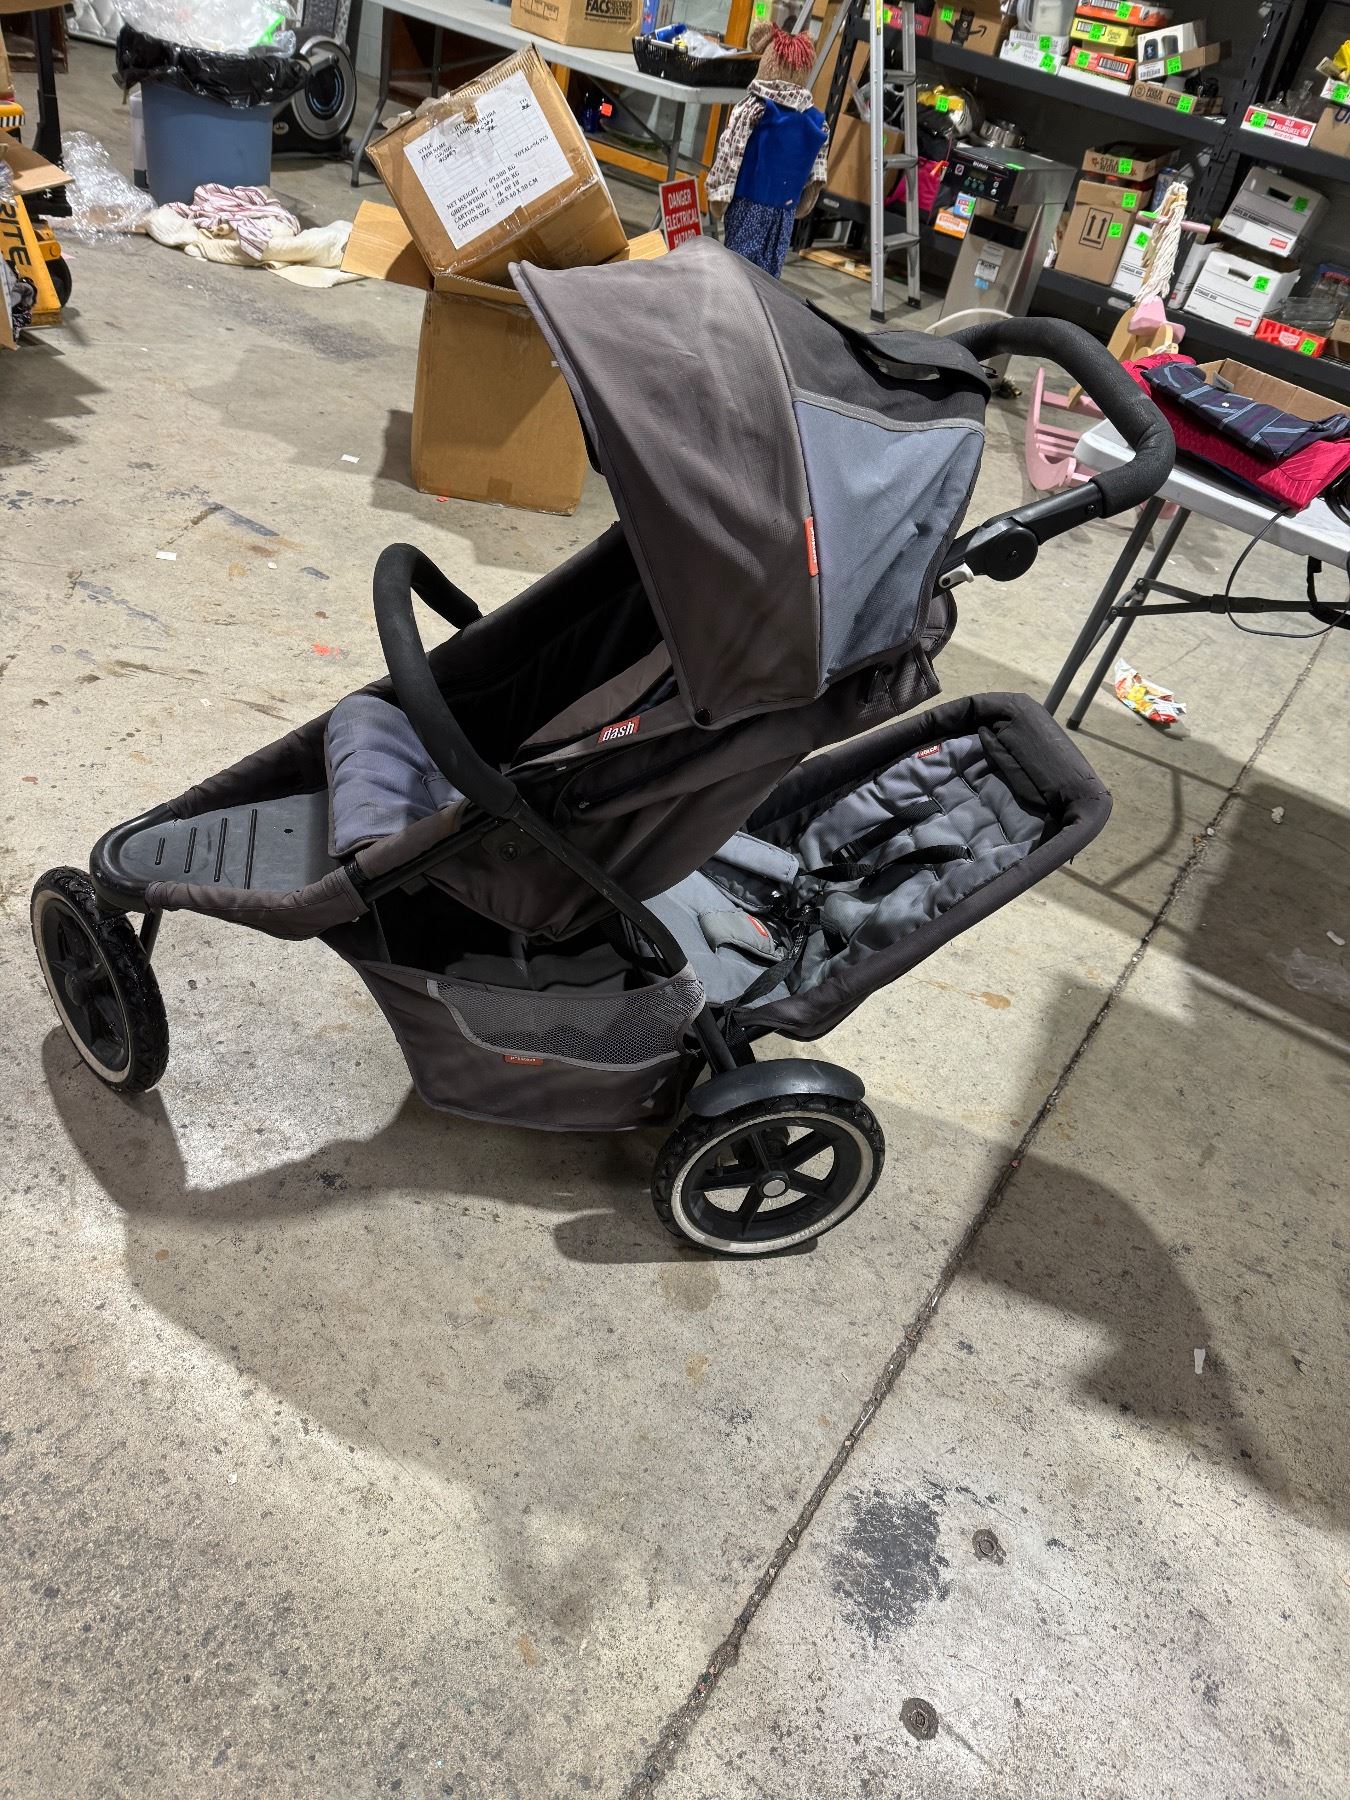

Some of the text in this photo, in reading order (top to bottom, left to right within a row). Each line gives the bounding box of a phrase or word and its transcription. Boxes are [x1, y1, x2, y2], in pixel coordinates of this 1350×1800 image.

[586, 0, 610, 13] FACS
[446, 201, 458, 210] NET
[457, 186, 479, 203] WEIGHT
[507, 163, 516, 172] KG
[450, 204, 468, 217] GROSS
[467, 190, 489, 207] WEIGHT
[511, 170, 520, 179] KG
[454, 207, 476, 224] CARTON
[475, 202, 486, 211] NO.
[504, 184, 512, 192] OF
[668, 189, 692, 210] DANGER
[457, 215, 479, 231] CARTON
[479, 206, 491, 218] SIZE
[666, 208, 699, 231] ELECTRICAL
[1194, 287, 1210, 297] STORAGE
[602, 721, 635, 742] dash
